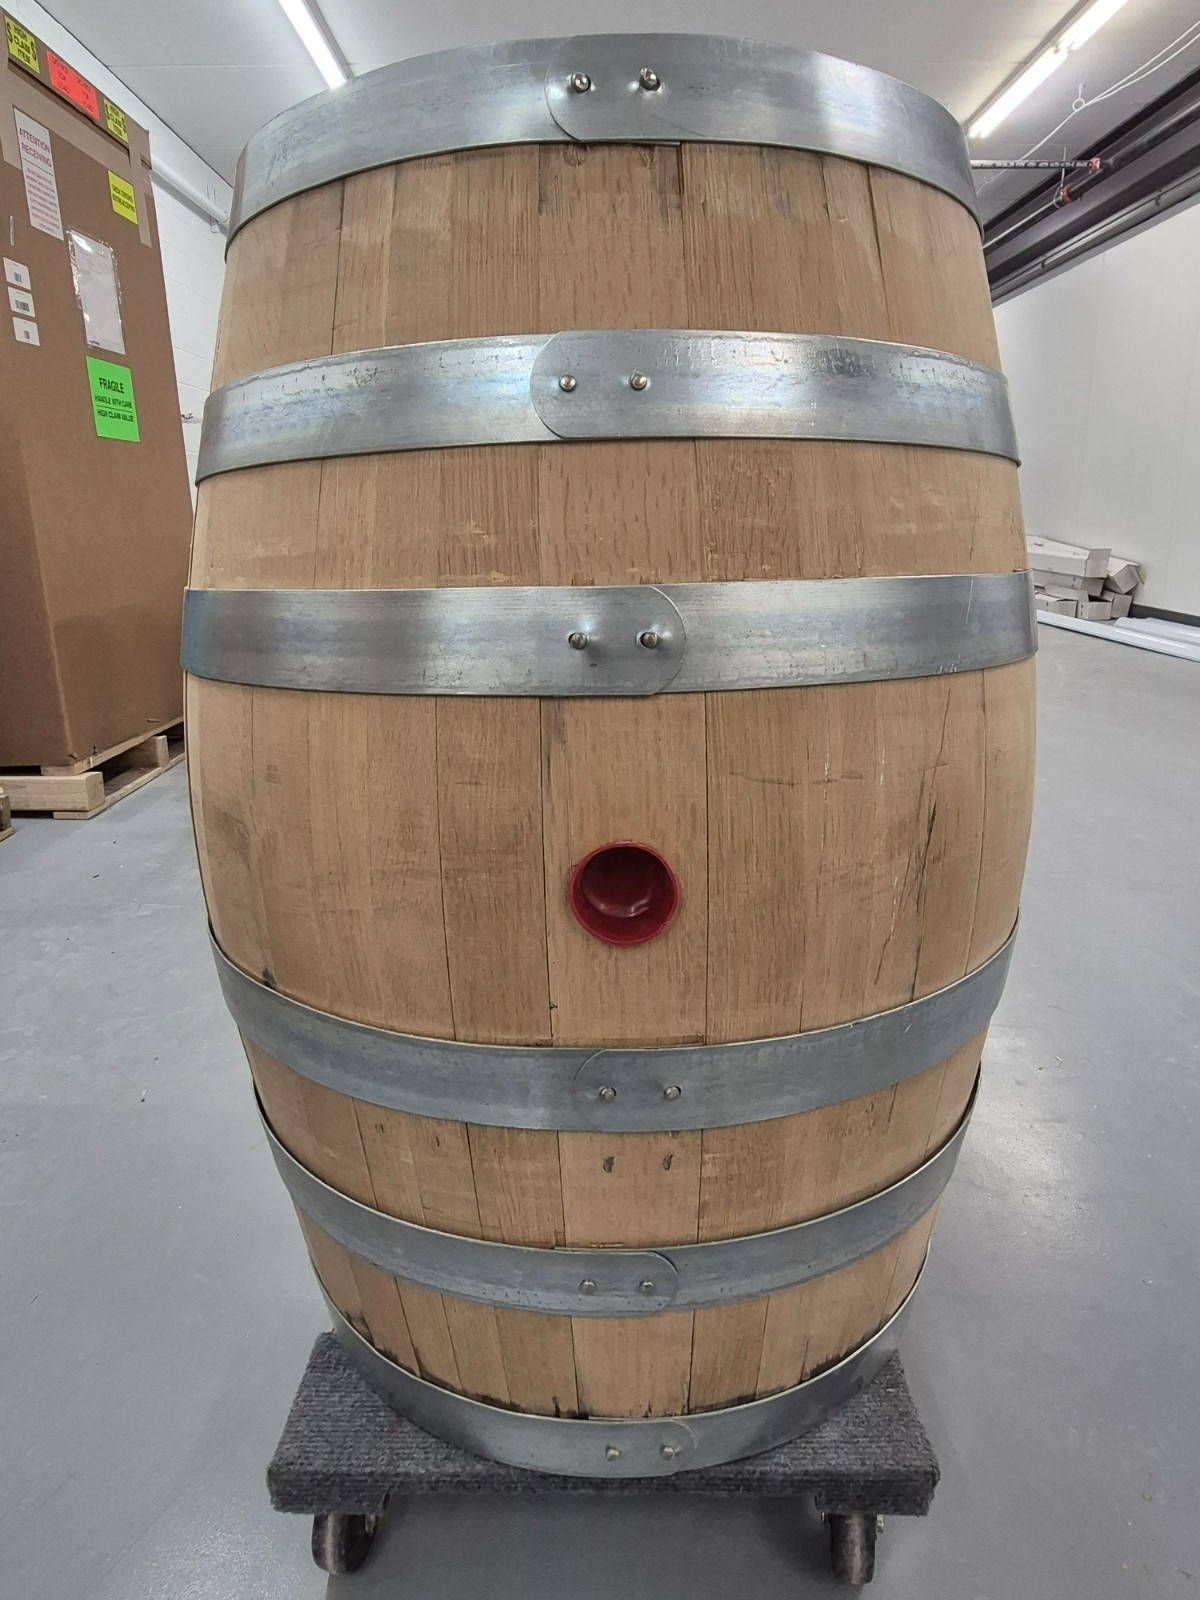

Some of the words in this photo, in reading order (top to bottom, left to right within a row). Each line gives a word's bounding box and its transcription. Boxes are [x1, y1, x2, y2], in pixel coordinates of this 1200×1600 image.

[13, 24, 27, 42] HIGH
[14, 34, 30, 54] CLAIM
[17, 48, 30, 64] ITEM
[19, 128, 50, 153] ATTENTION
[21, 142, 52, 168] RECEIVING
[98, 378, 124, 394] FRAGILE
[94, 395, 112, 405] HANDLE
[112, 398, 122, 406] WITH
[122, 400, 132, 408] CARE
[97, 409, 108, 417] HIGH
